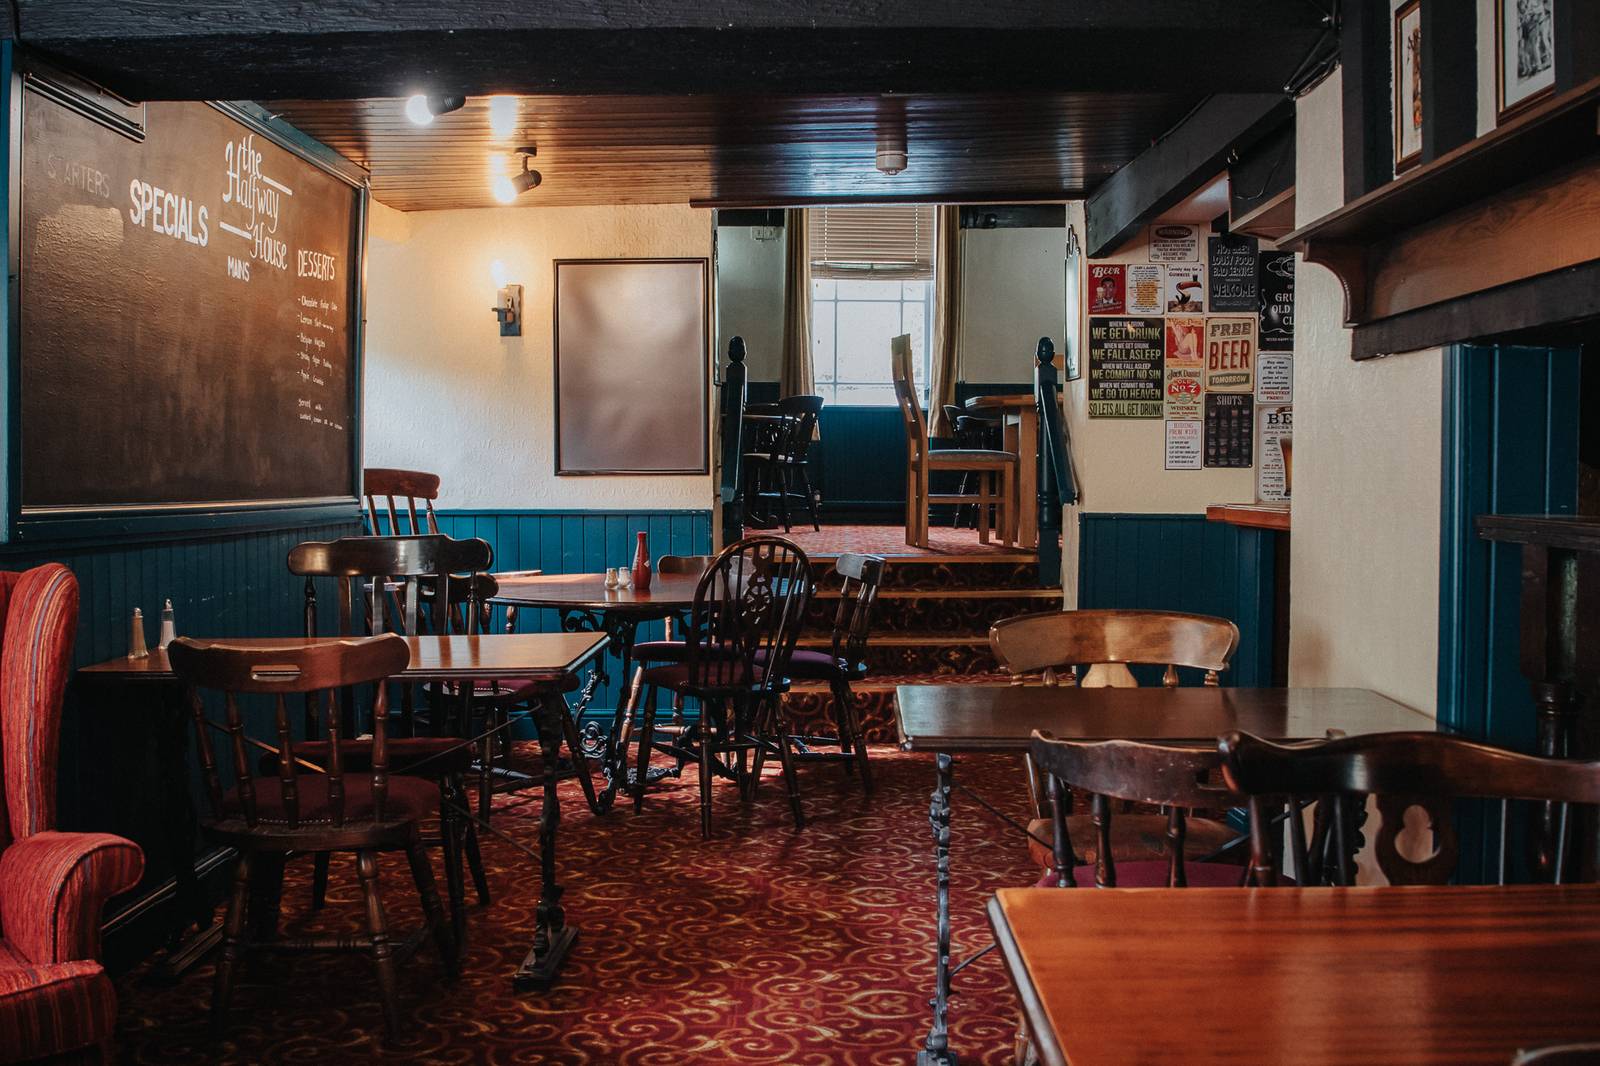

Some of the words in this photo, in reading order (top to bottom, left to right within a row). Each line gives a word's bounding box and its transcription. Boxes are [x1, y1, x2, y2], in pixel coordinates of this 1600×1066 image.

[241, 134, 263, 179] the
[222, 140, 279, 234] Halfway
[129, 179, 209, 247] SPECIALS
[250, 222, 288, 270] House
[298, 249, 335, 280] DESSERTS
[1234, 255, 1255, 266] FOOD
[227, 256, 250, 281] MAINS
[1092, 266, 1121, 278] BEER
[1213, 266, 1228, 277] BAD
[1213, 283, 1256, 298] WELCOME
[1271, 304, 1291, 314] OLD
[1092, 328, 1107, 339] WE
[1109, 328, 1127, 339] GET
[1129, 327, 1161, 340] DRUNK
[1210, 322, 1251, 337] FREE
[1092, 349, 1105, 360] WE
[1107, 349, 1128, 360] FALL
[1129, 349, 1161, 360] ASLEEP
[1209, 339, 1250, 370] BEER
[1091, 369, 1104, 379] WE
[1105, 369, 1135, 379] COMMIT
[1136, 369, 1147, 379] NO
[1148, 369, 1161, 379] SIN
[1212, 375, 1247, 385] TOMORROW
[1188, 382, 1198, 392] 7
[1091, 389, 1104, 399] WE
[1106, 389, 1116, 399] GO
[1118, 389, 1128, 399] TO
[1130, 389, 1161, 399] HEAVEN
[1216, 395, 1243, 405] SHOTS
[1088, 403, 1098, 415] SO
[1115, 403, 1126, 415] ALL
[1127, 403, 1139, 415] GET
